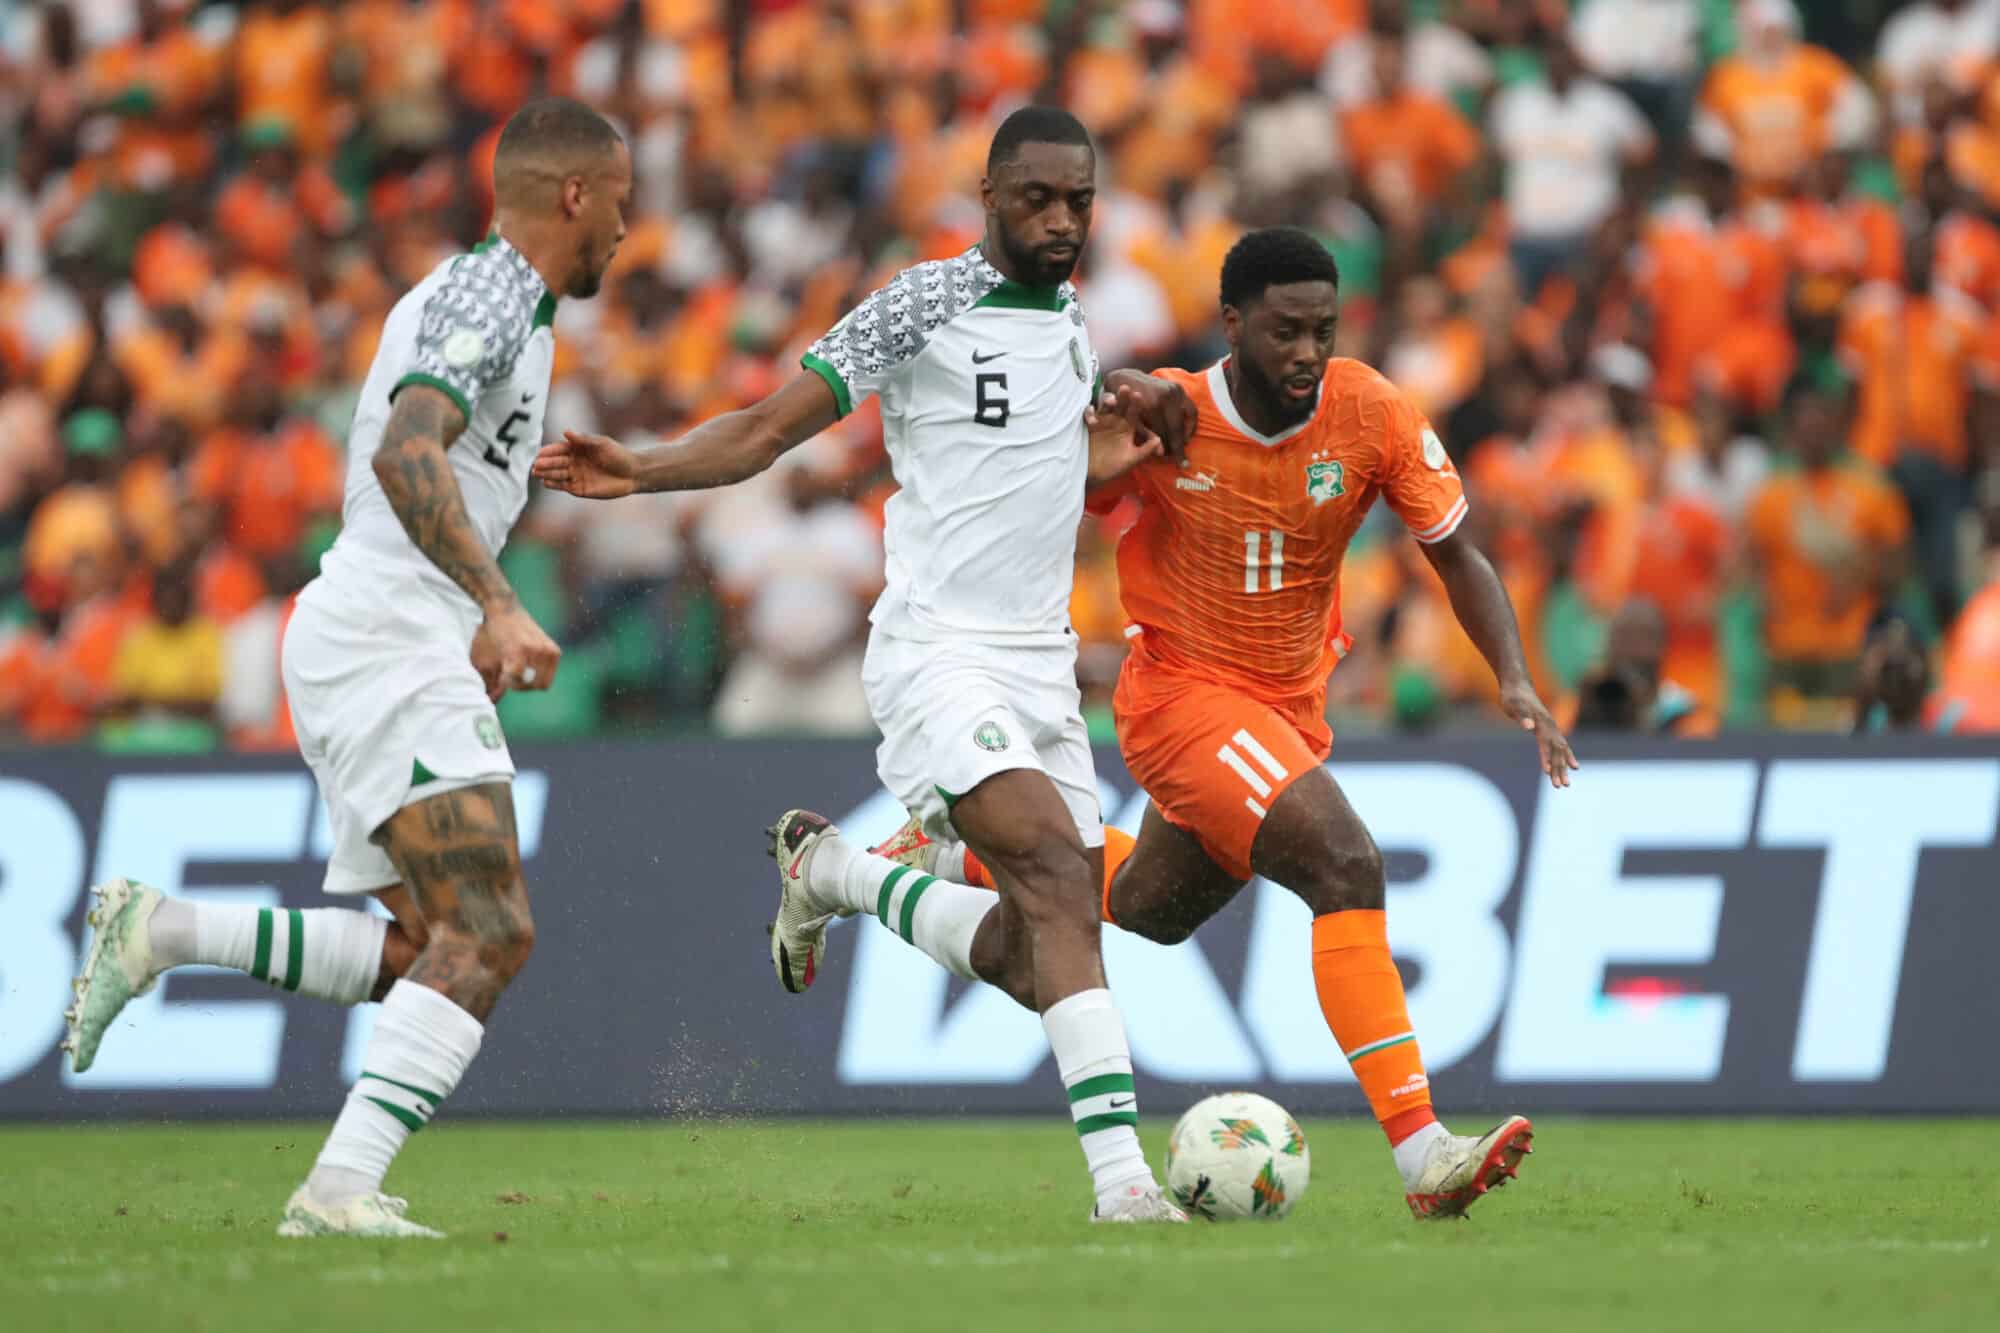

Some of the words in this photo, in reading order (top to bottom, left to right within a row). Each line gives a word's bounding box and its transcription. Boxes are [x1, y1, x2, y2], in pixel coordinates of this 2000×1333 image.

[974, 373, 1010, 427] 6
[484, 411, 531, 470] 5
[1176, 477, 1210, 492] PUMA
[1244, 530, 1285, 593] 11
[1216, 727, 1289, 799] 11
